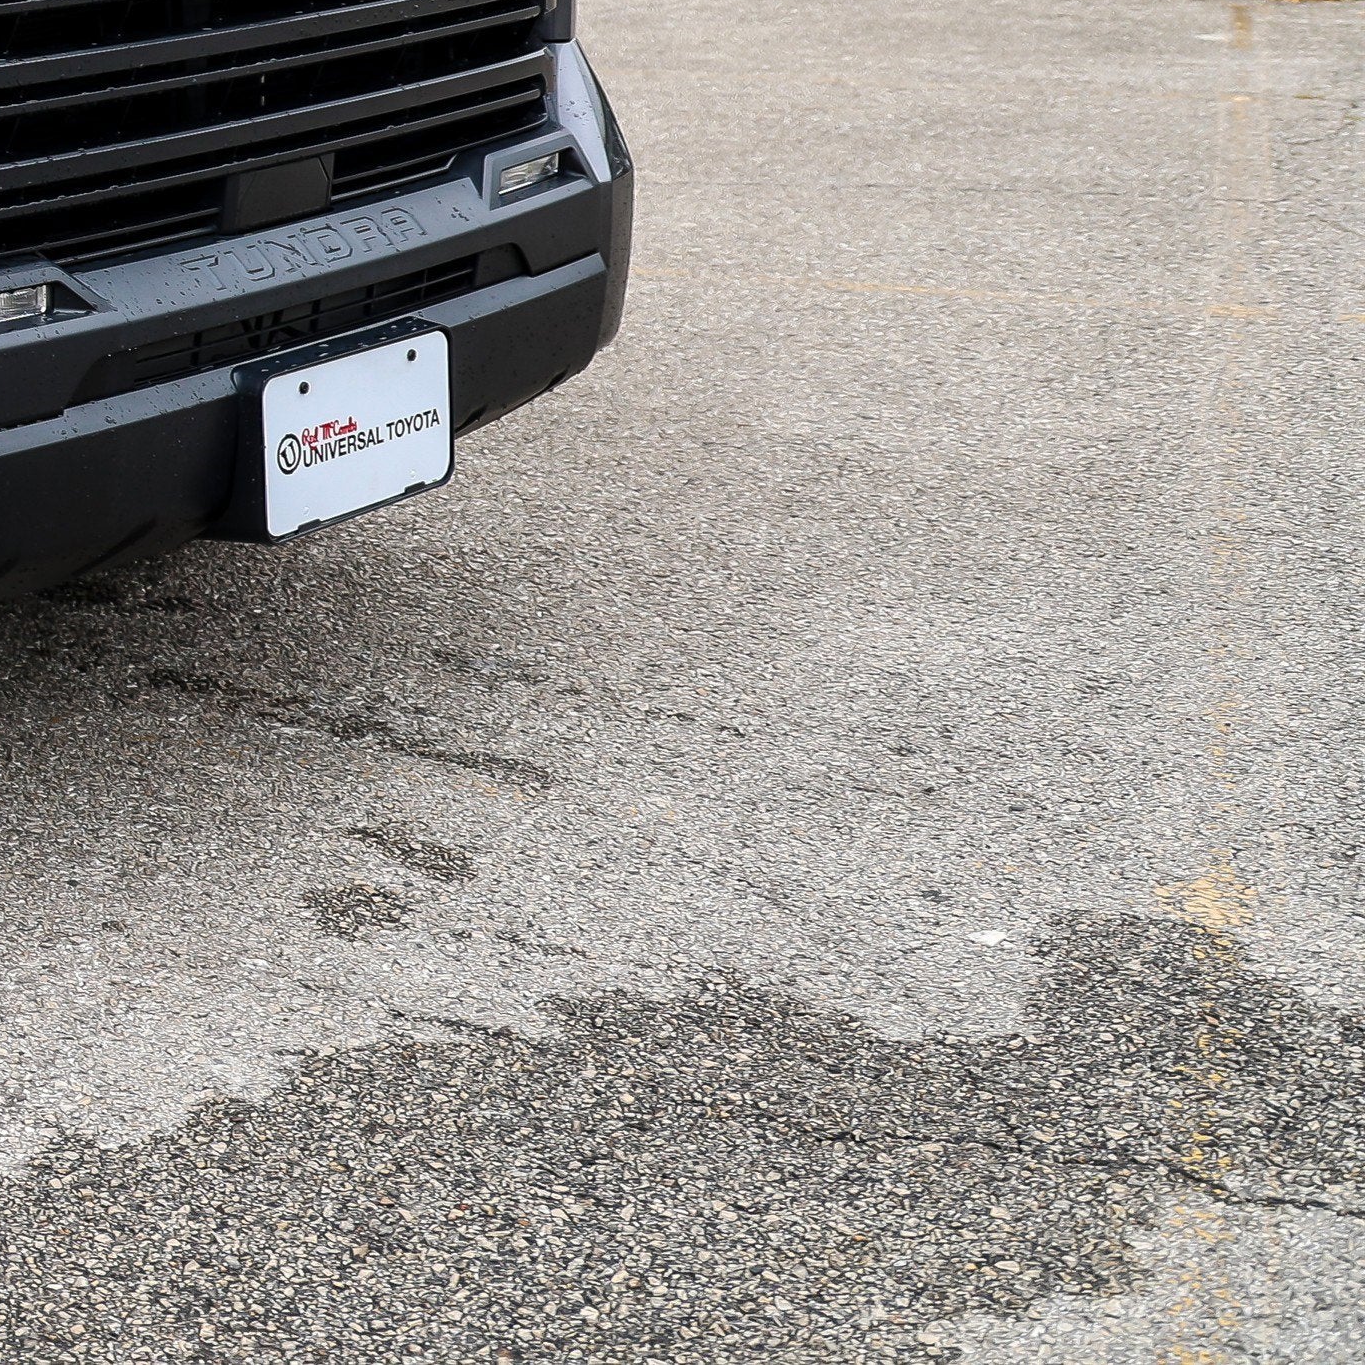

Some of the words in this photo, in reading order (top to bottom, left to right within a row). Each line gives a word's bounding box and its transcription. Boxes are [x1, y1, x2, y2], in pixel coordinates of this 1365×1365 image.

[178, 207, 428, 290] TUNDRA
[303, 427, 385, 468] UNIVERSAL
[386, 408, 441, 441] TOYOTA
